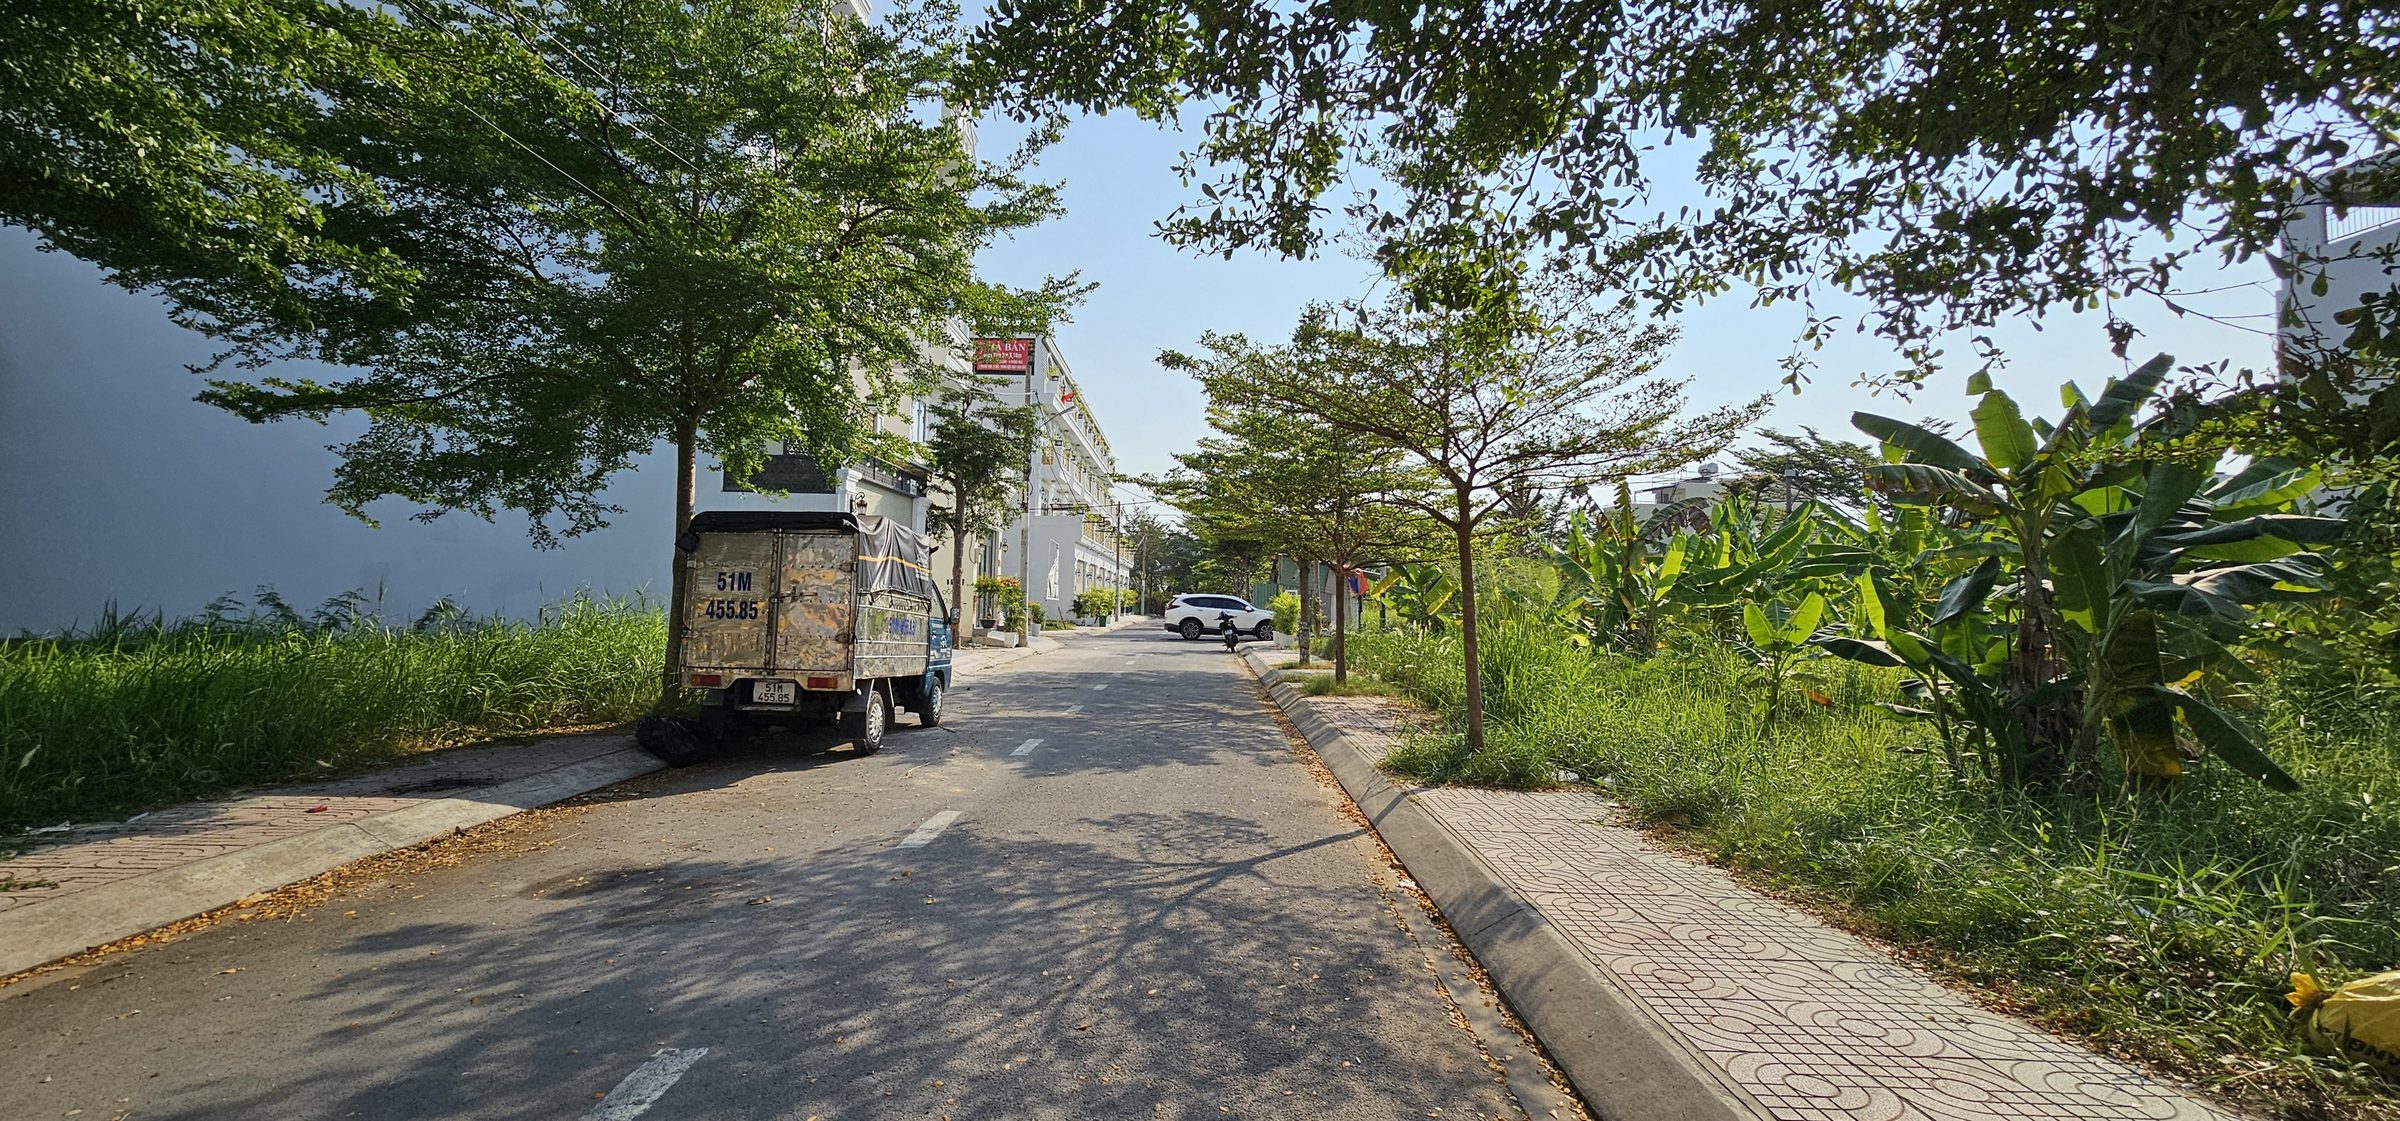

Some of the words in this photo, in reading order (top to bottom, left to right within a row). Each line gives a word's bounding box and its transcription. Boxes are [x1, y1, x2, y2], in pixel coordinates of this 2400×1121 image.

[717, 572, 752, 591] 51M
[705, 599, 758, 620] 455.85
[765, 683, 783, 693] 51M
